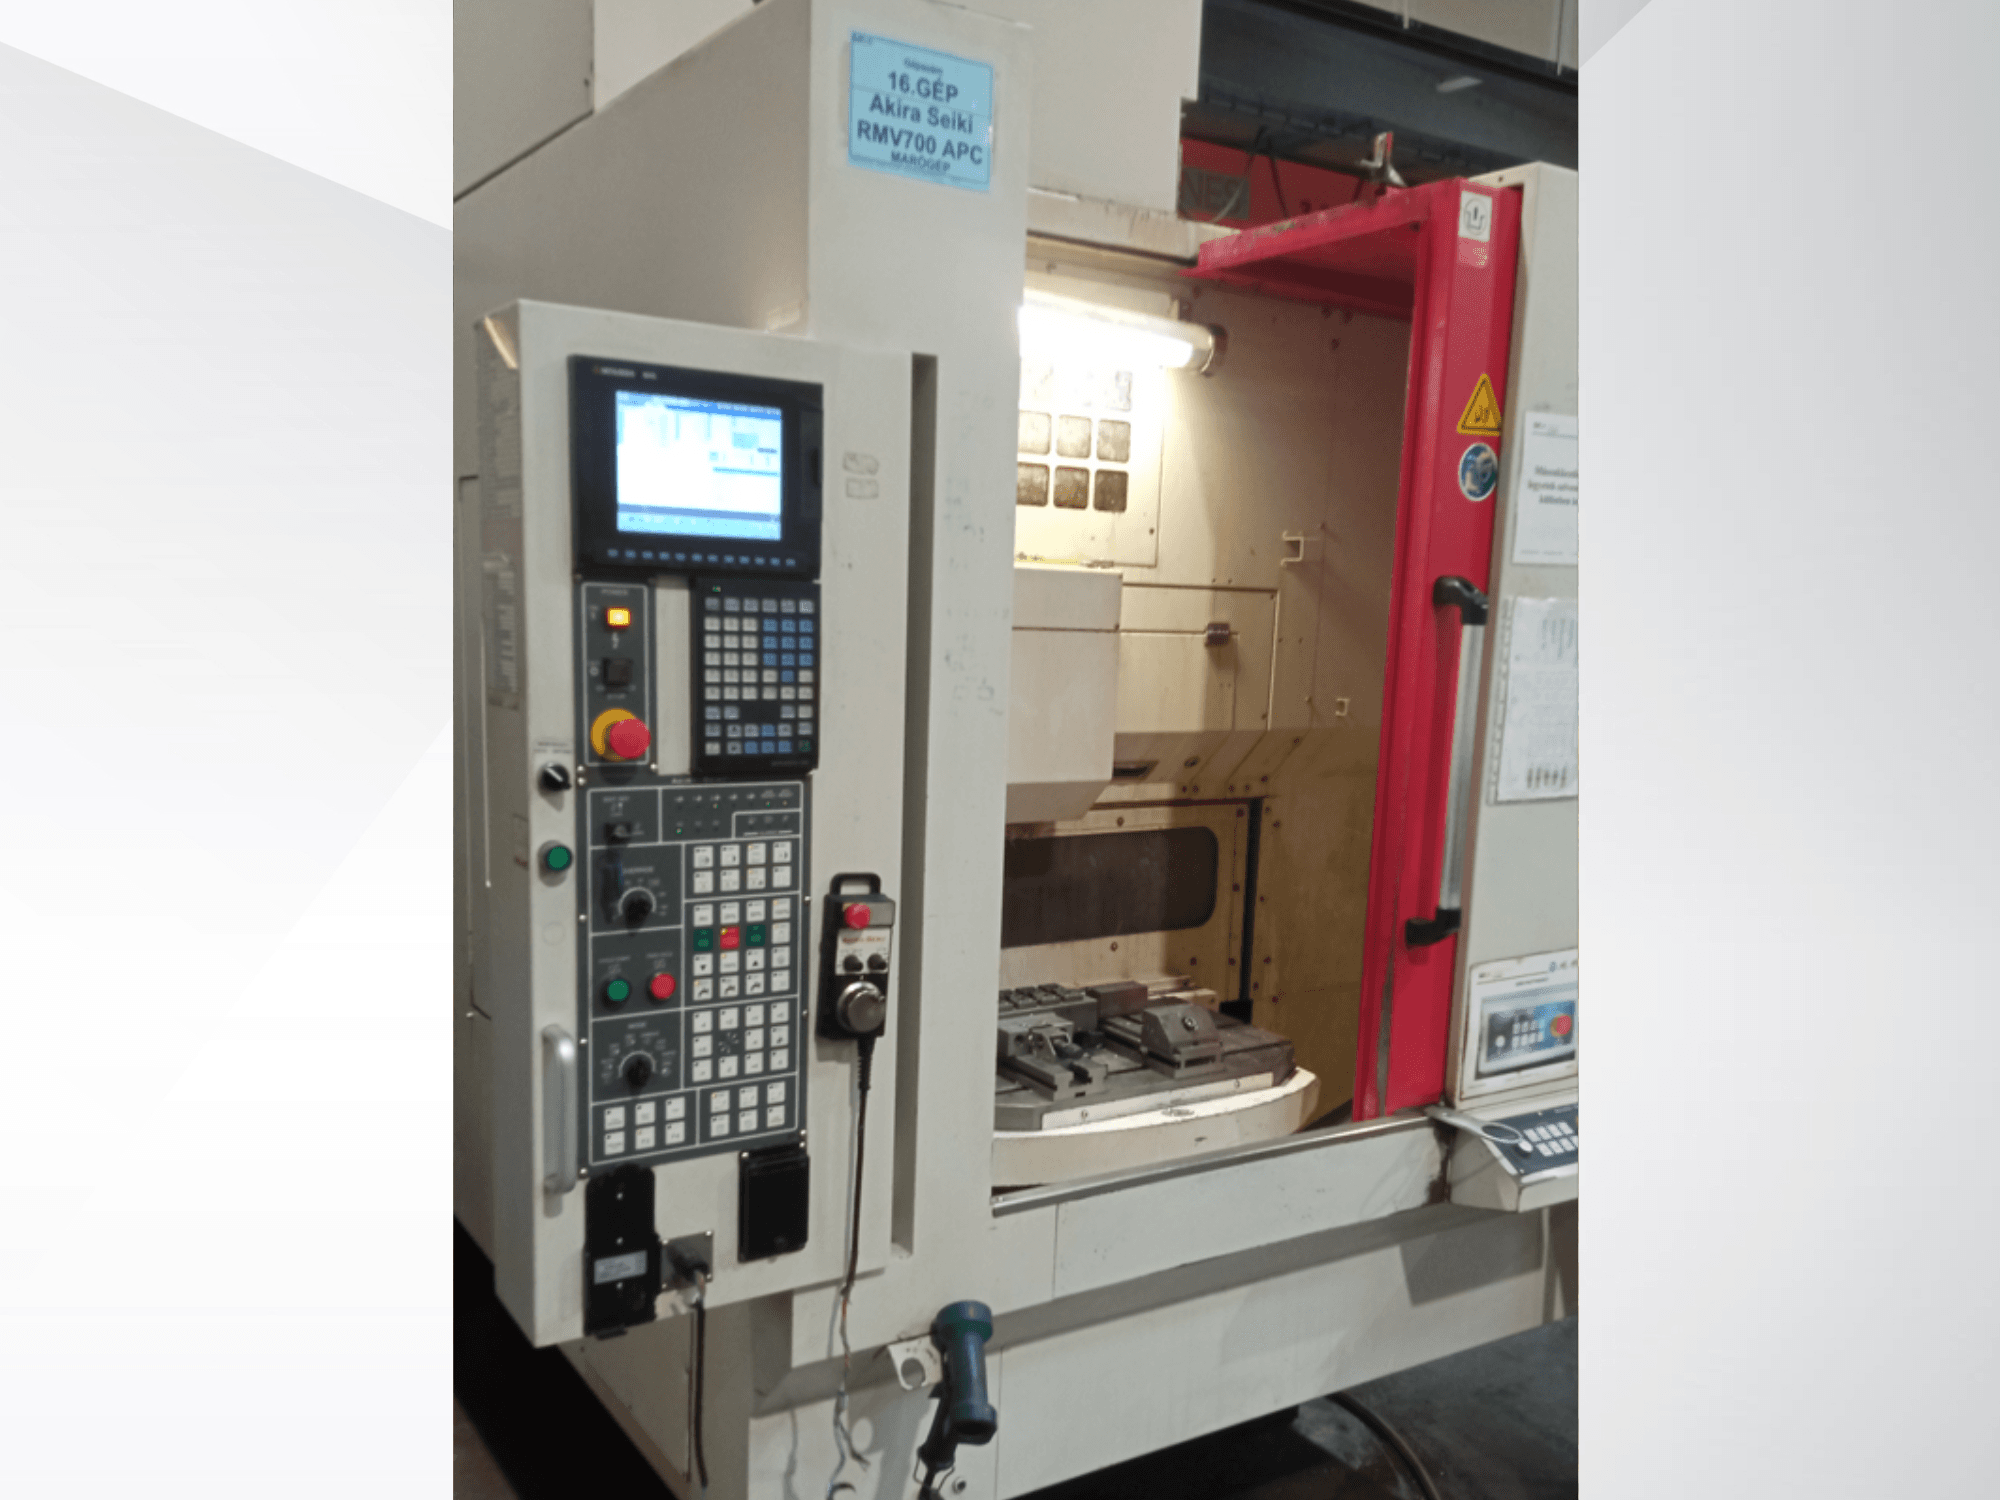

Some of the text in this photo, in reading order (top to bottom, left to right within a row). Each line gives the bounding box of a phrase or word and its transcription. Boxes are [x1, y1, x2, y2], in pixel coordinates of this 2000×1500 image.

[888, 70, 959, 103] 16.GÉP
[869, 92, 974, 134] Akira Seiki
[857, 118, 983, 166] RMV700 APC
